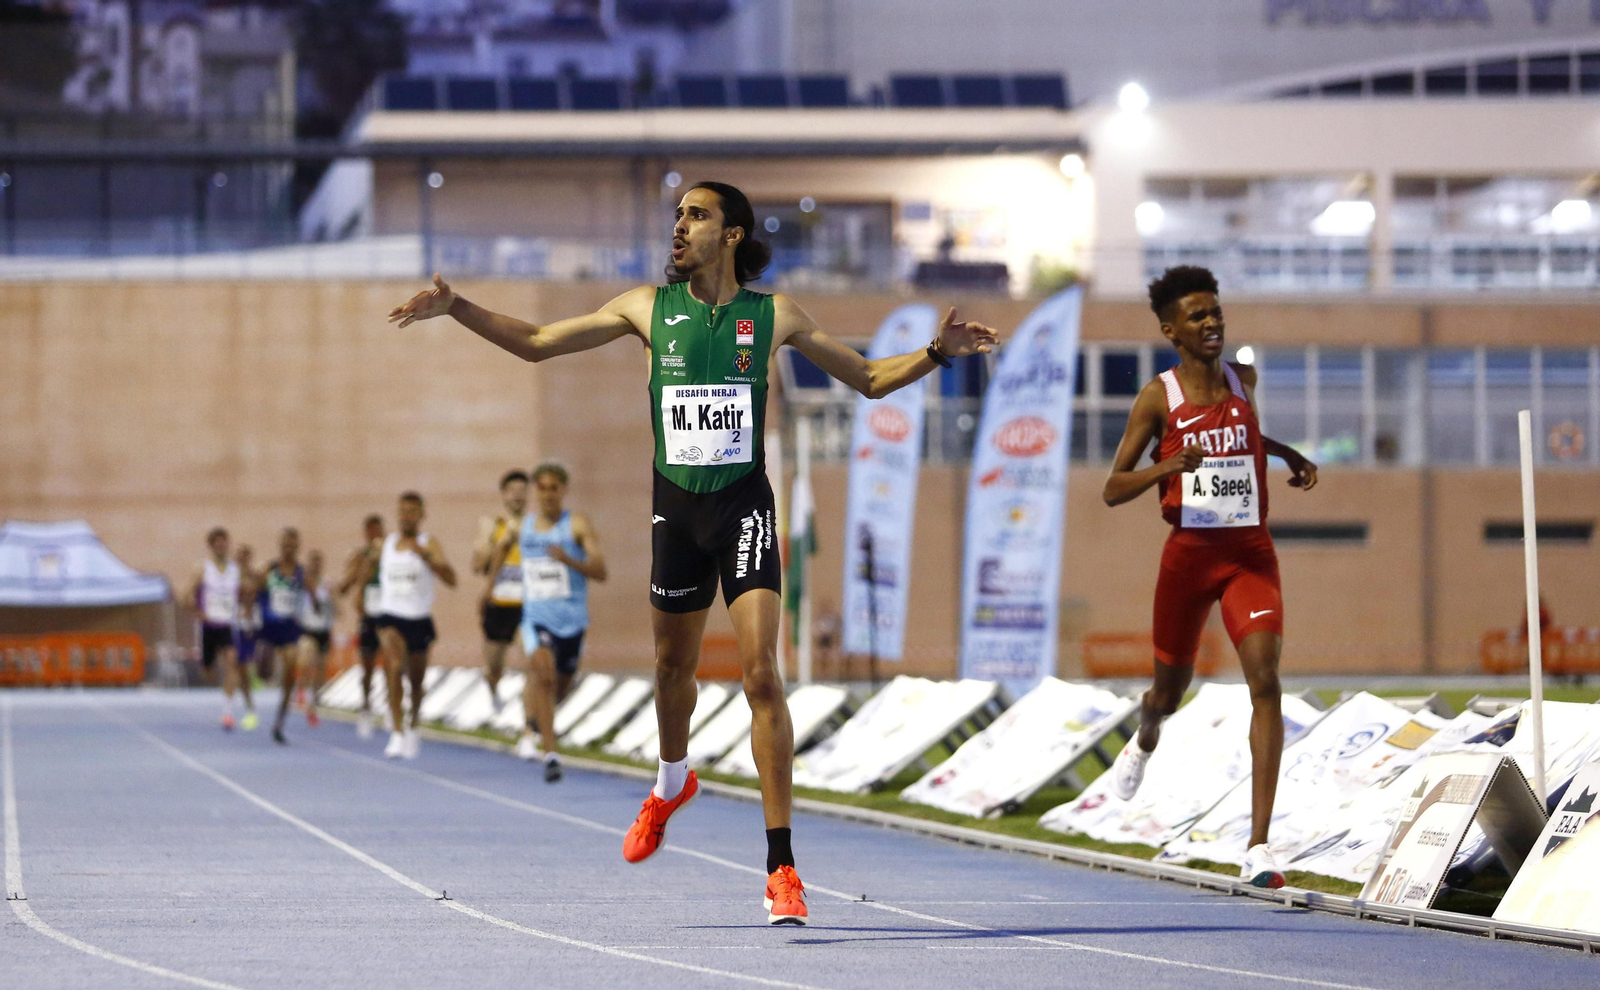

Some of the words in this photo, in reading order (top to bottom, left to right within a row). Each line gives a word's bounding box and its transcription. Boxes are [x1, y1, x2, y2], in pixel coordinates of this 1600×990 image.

[676, 388, 709, 398] DESAFÍO
[711, 388, 738, 398] NERJA
[672, 404, 692, 431] M.
[698, 404, 744, 431] Katir
[732, 430, 741, 443] 2
[1183, 424, 1248, 455] QATAR
[1226, 460, 1246, 468] NERJA
[1192, 475, 1206, 497] A.
[1211, 472, 1252, 497] Saeed
[1242, 496, 1250, 507] 5
[651, 583, 666, 596] UJI
